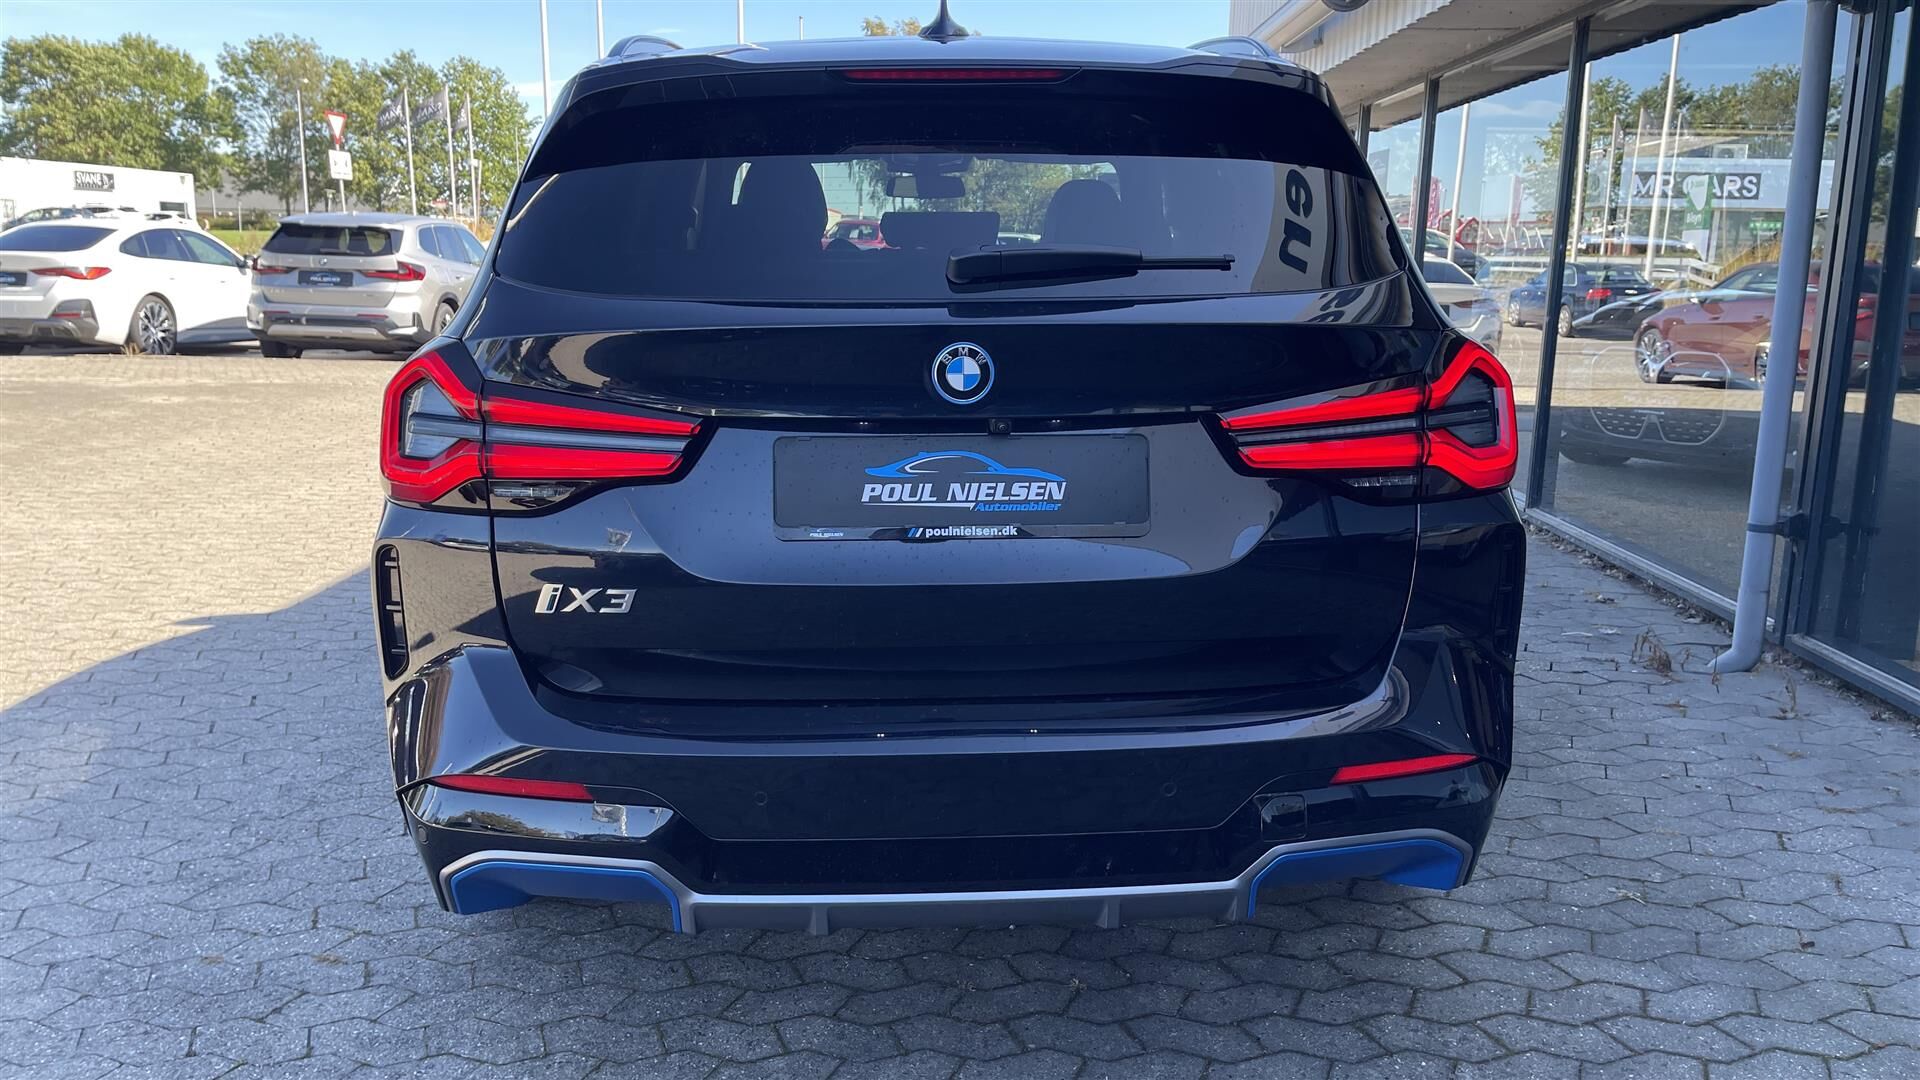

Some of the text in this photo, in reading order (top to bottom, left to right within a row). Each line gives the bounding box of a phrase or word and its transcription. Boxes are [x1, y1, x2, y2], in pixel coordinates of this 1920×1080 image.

[941, 347, 987, 366] BMW
[861, 482, 1067, 502] POUL NIELSEN
[975, 502, 1062, 512] Automobiler
[925, 526, 1018, 538] poulnielsen.dk
